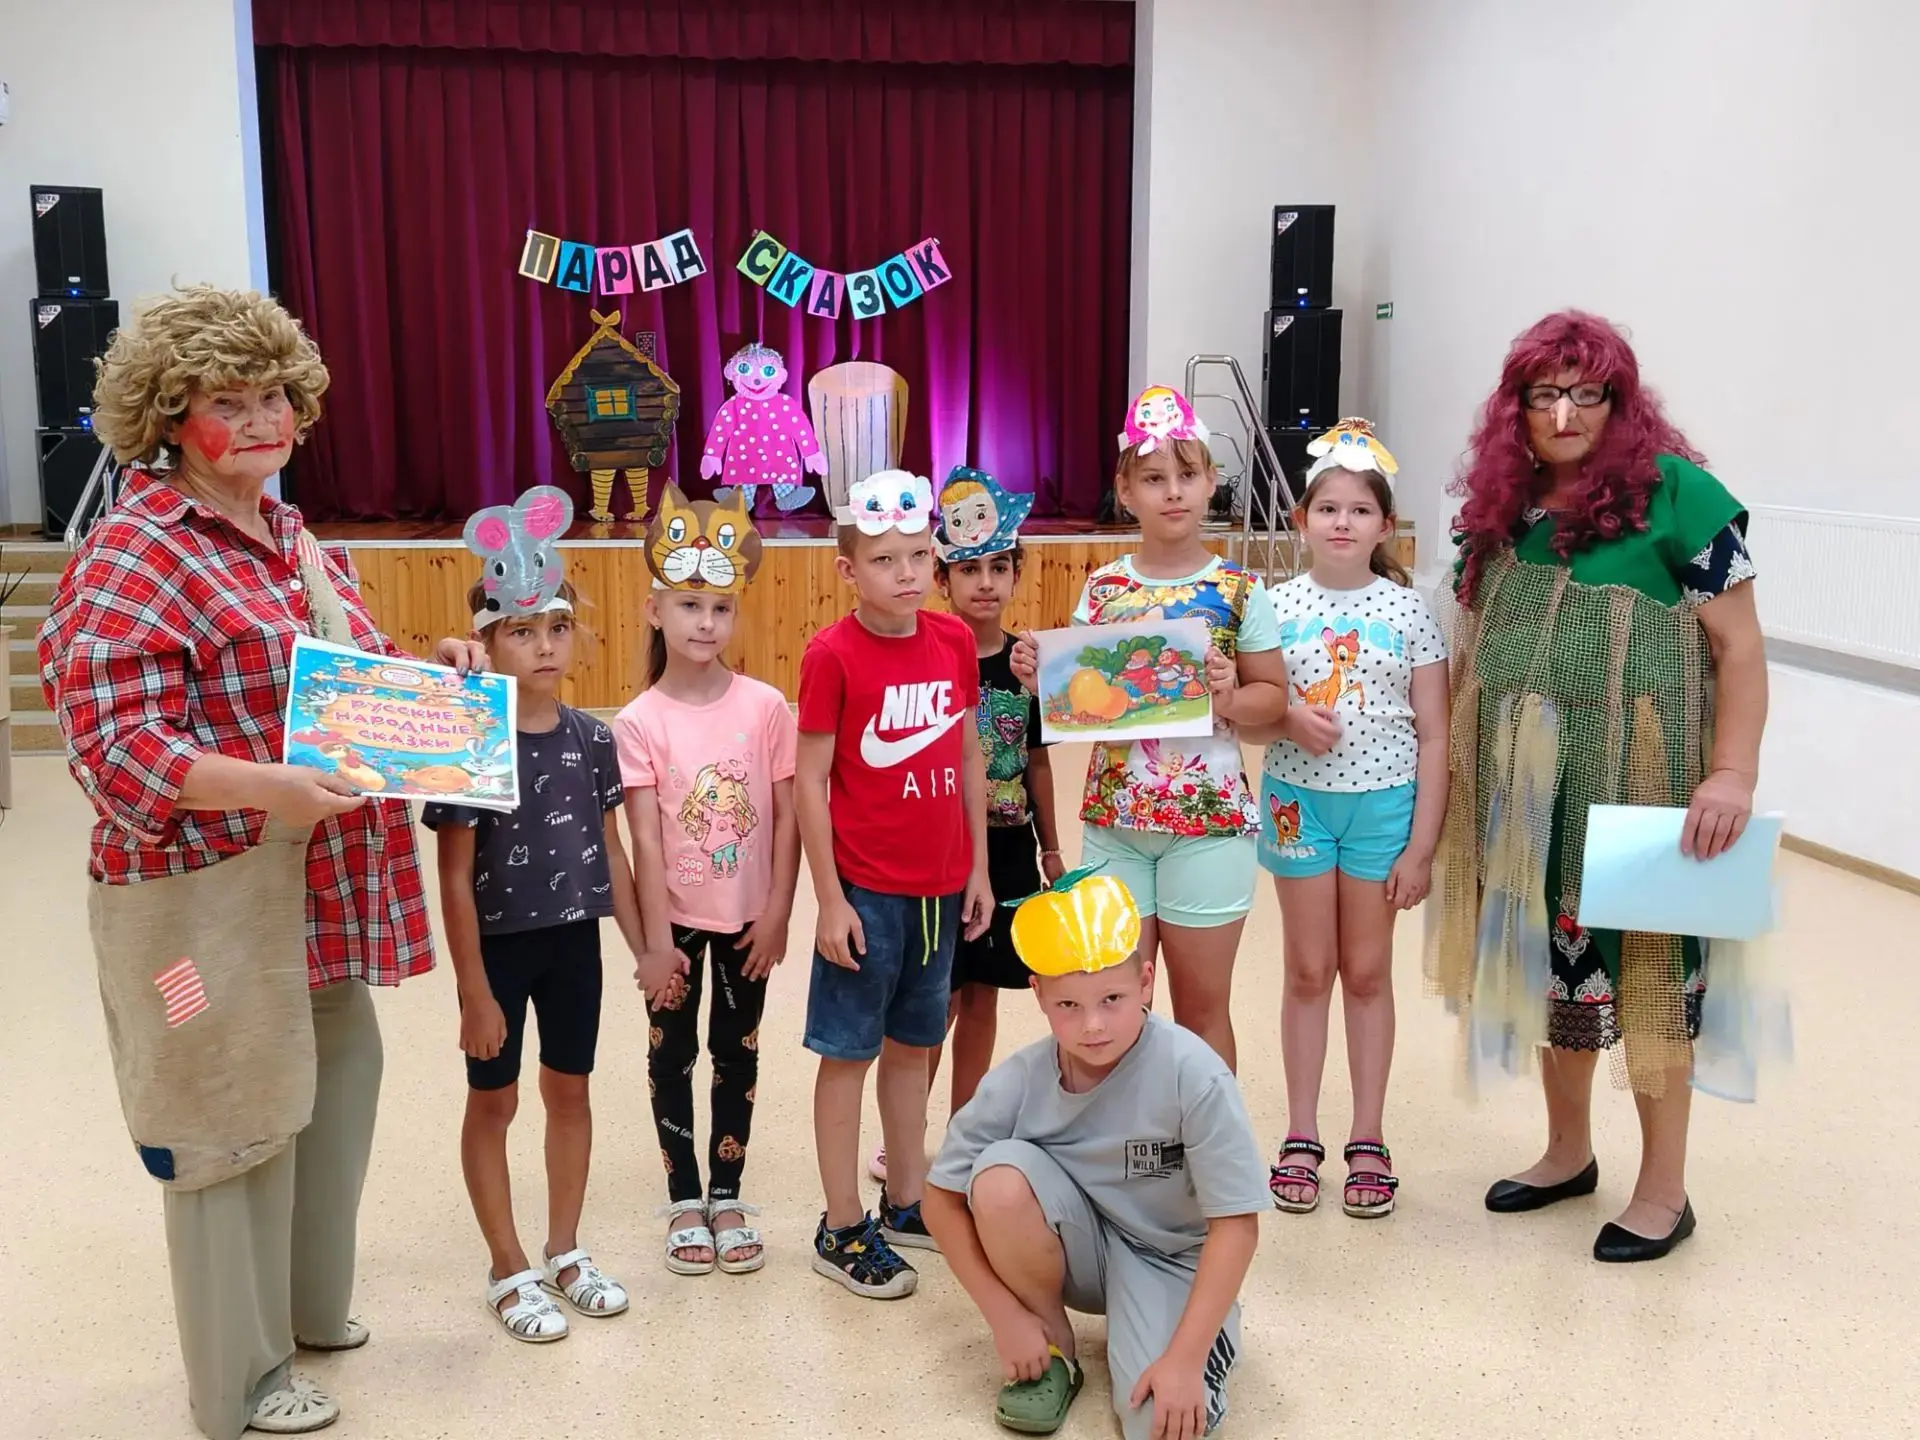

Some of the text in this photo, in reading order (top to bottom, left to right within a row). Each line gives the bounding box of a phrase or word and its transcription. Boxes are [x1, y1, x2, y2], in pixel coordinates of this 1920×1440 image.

[523, 232, 950, 317] ПАРАД СКАЗОК
[1280, 616, 1405, 660] BAMBI
[351, 700, 454, 720] РУССКИЕ
[879, 680, 952, 731] NIKE
[335, 711, 470, 735] НАРОДНЫЕ
[358, 730, 450, 748] СКАЗКИ
[561, 751, 582, 760] JUST
[902, 767, 956, 799] AIR
[1133, 1144, 1147, 1156] TO
[1133, 1160, 1154, 1170] WILD
